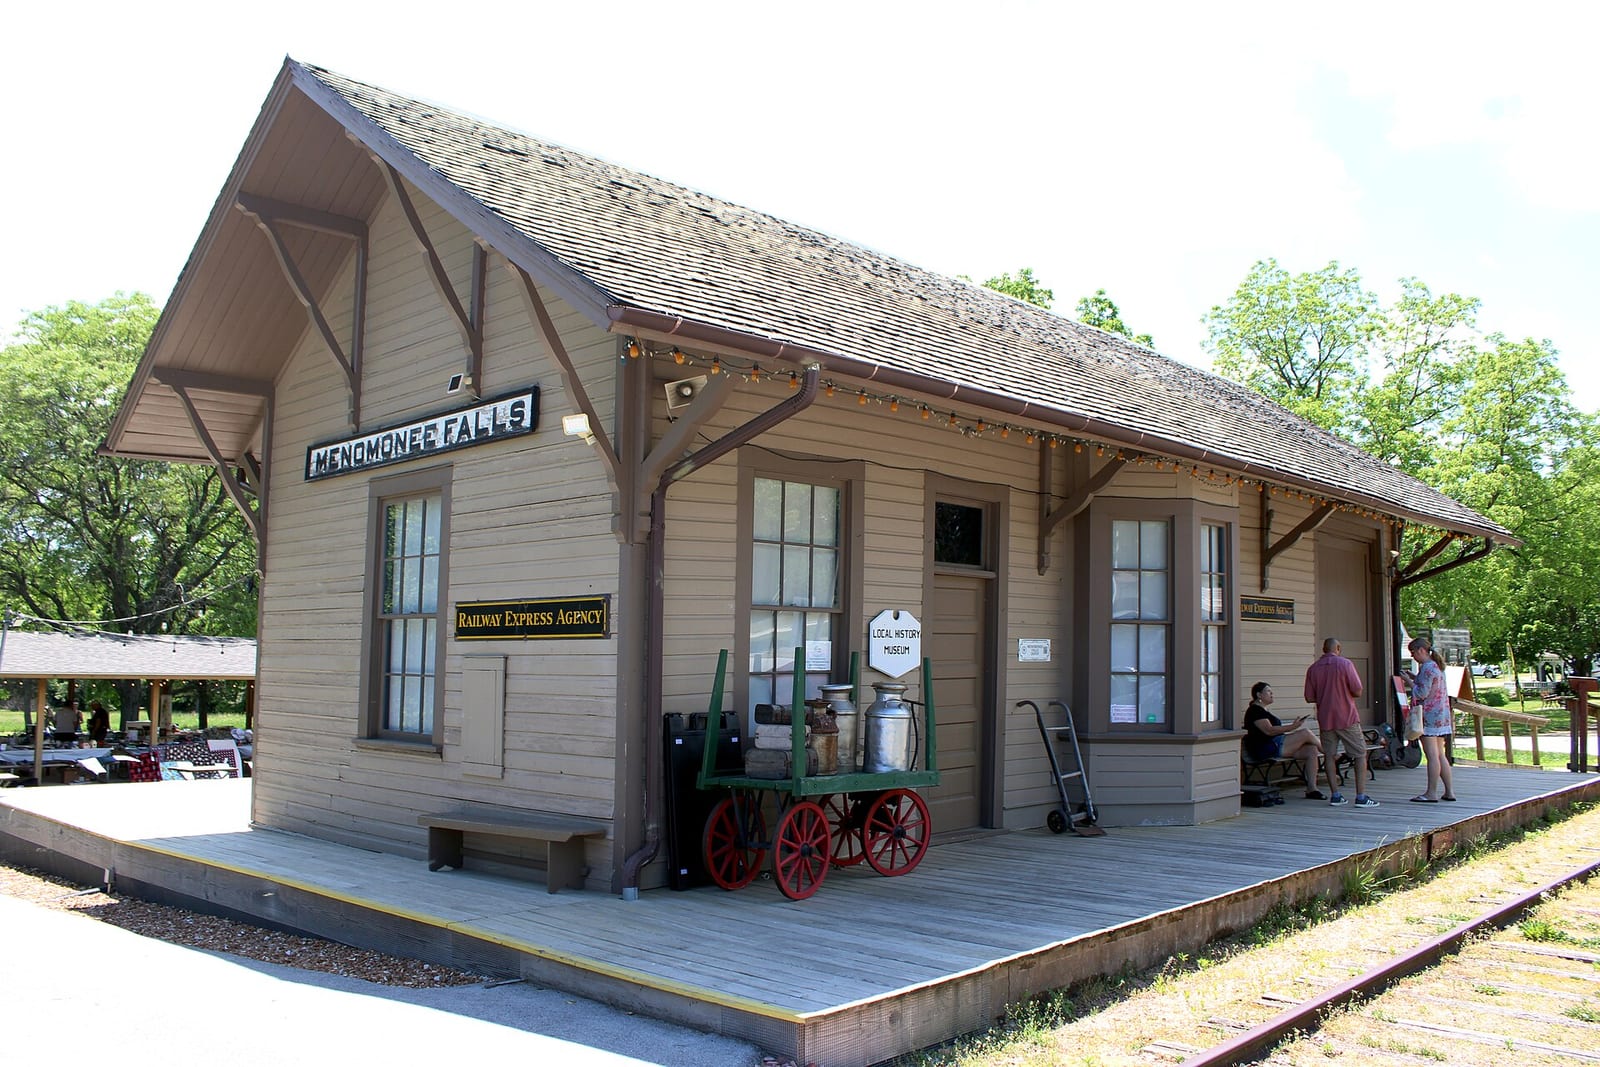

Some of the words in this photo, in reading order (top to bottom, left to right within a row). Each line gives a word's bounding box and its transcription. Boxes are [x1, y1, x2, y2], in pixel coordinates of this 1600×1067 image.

[315, 422, 438, 472] MENOMONEE
[444, 400, 526, 444] FALLS
[458, 612, 503, 628] RAILWAY
[504, 610, 553, 627] EXPRESS
[556, 608, 603, 625] AGENCY
[872, 628, 893, 639] LOCAL
[895, 629, 921, 639] HISTORY
[883, 645, 910, 655] MUSEUM
